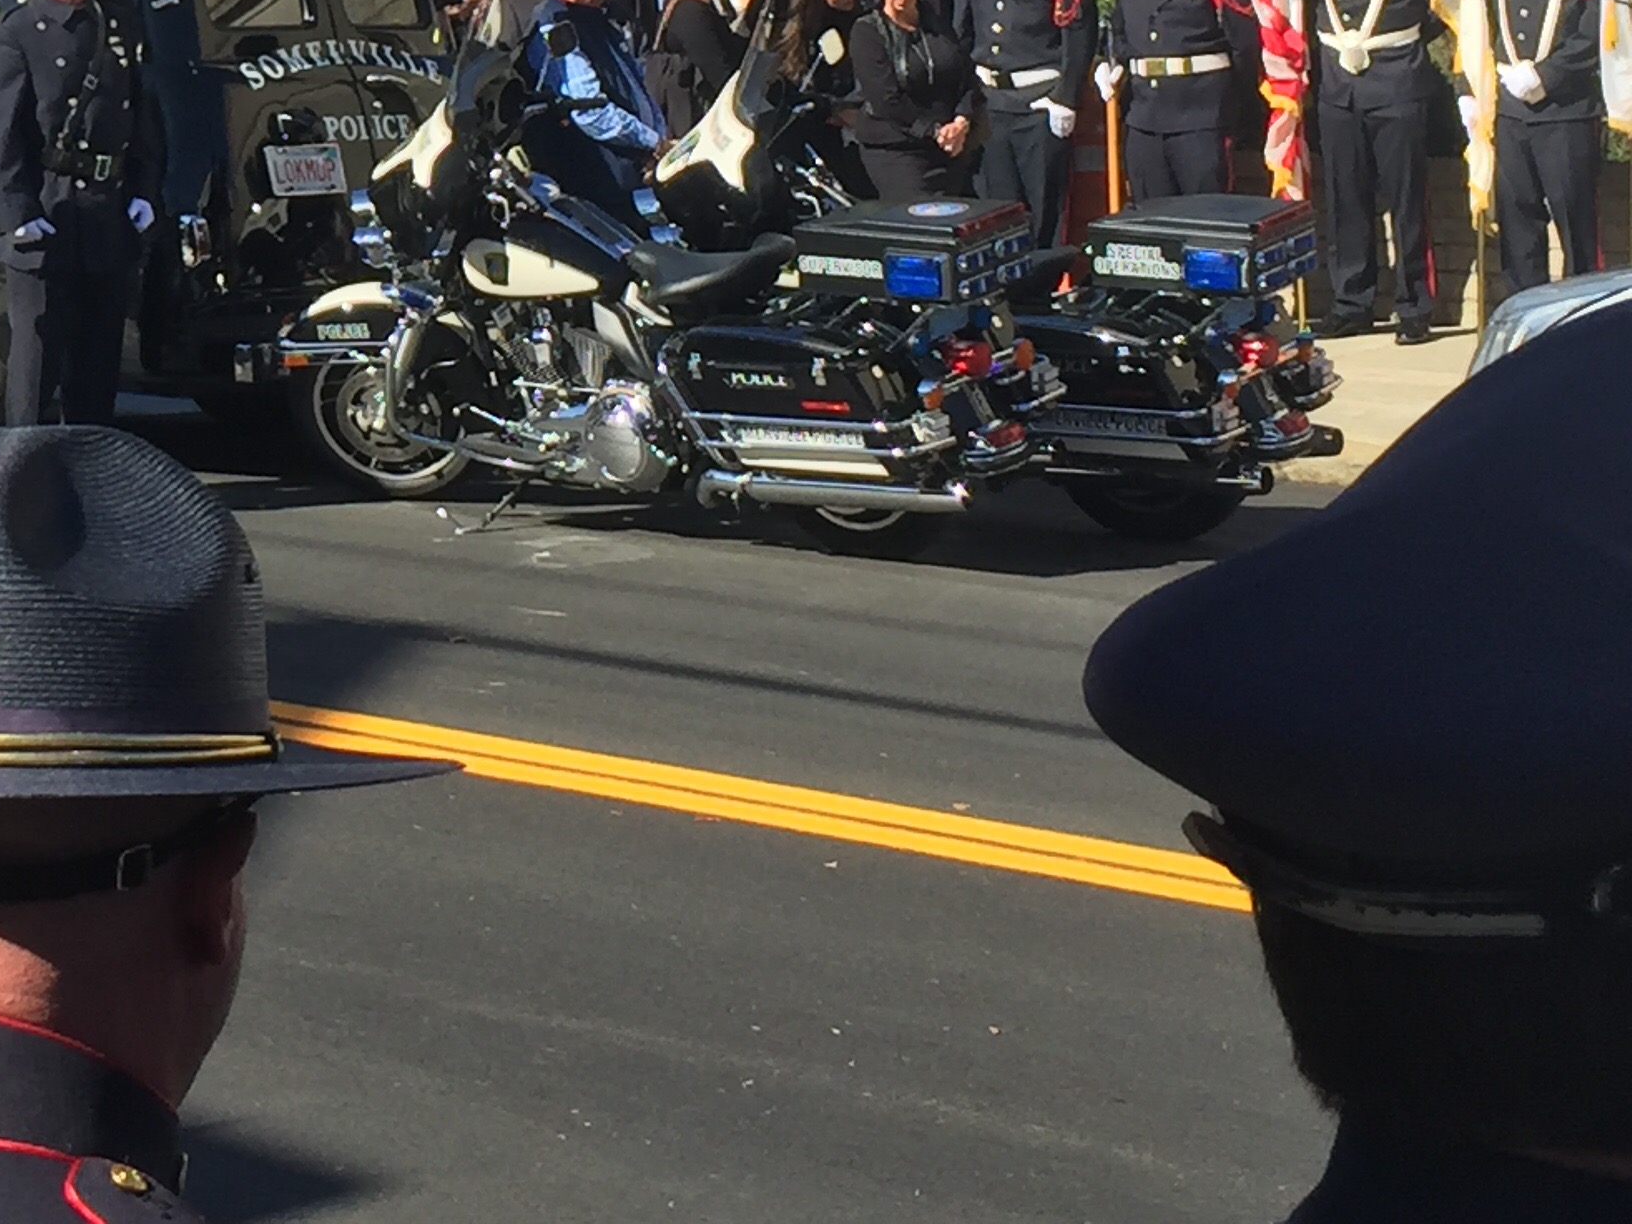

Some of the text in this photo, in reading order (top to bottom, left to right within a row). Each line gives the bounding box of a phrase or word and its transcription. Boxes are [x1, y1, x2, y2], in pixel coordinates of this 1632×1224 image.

[239, 39, 443, 91] SOMERVILLE
[323, 114, 412, 142] POLICE
[316, 323, 371, 341] POLICE
